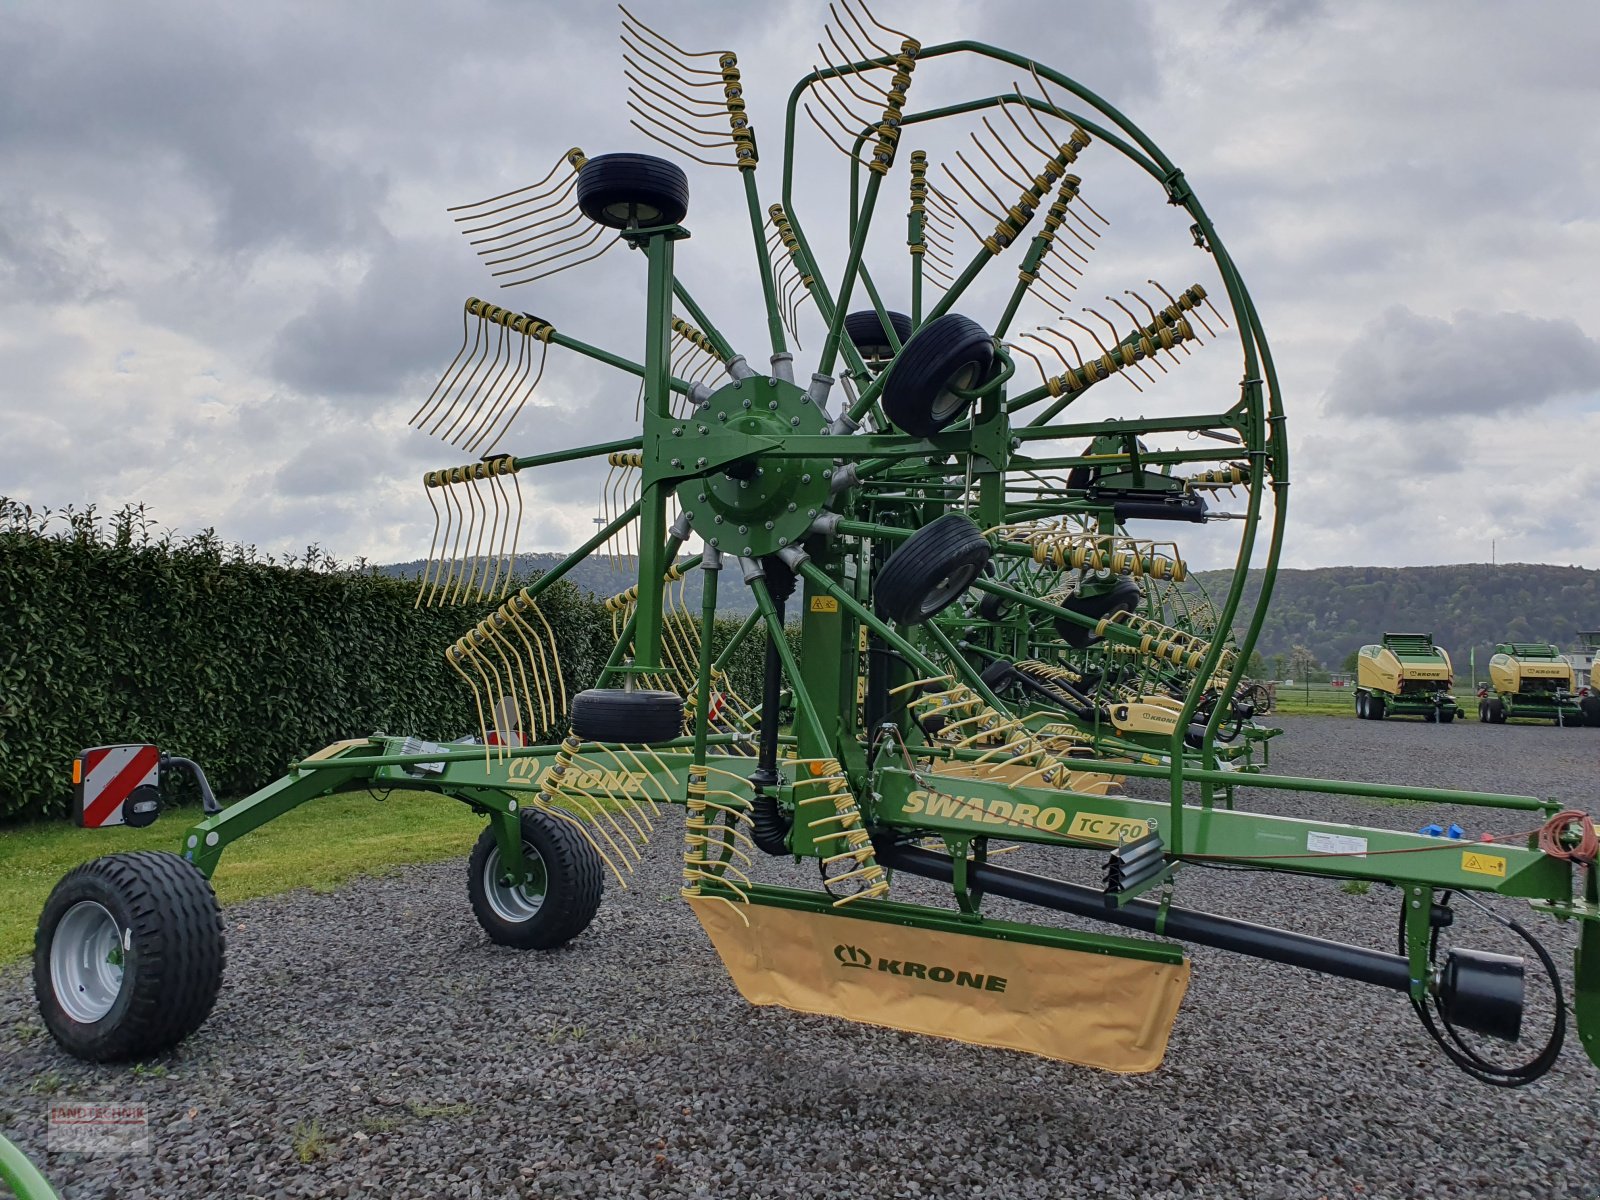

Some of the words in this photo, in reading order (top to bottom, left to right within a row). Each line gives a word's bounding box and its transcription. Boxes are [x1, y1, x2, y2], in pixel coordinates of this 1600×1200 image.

[901, 790, 1066, 831] SWADRO
[1080, 818, 1103, 834] TC
[1109, 822, 1142, 839] 760
[878, 958, 1008, 993] KRONE
